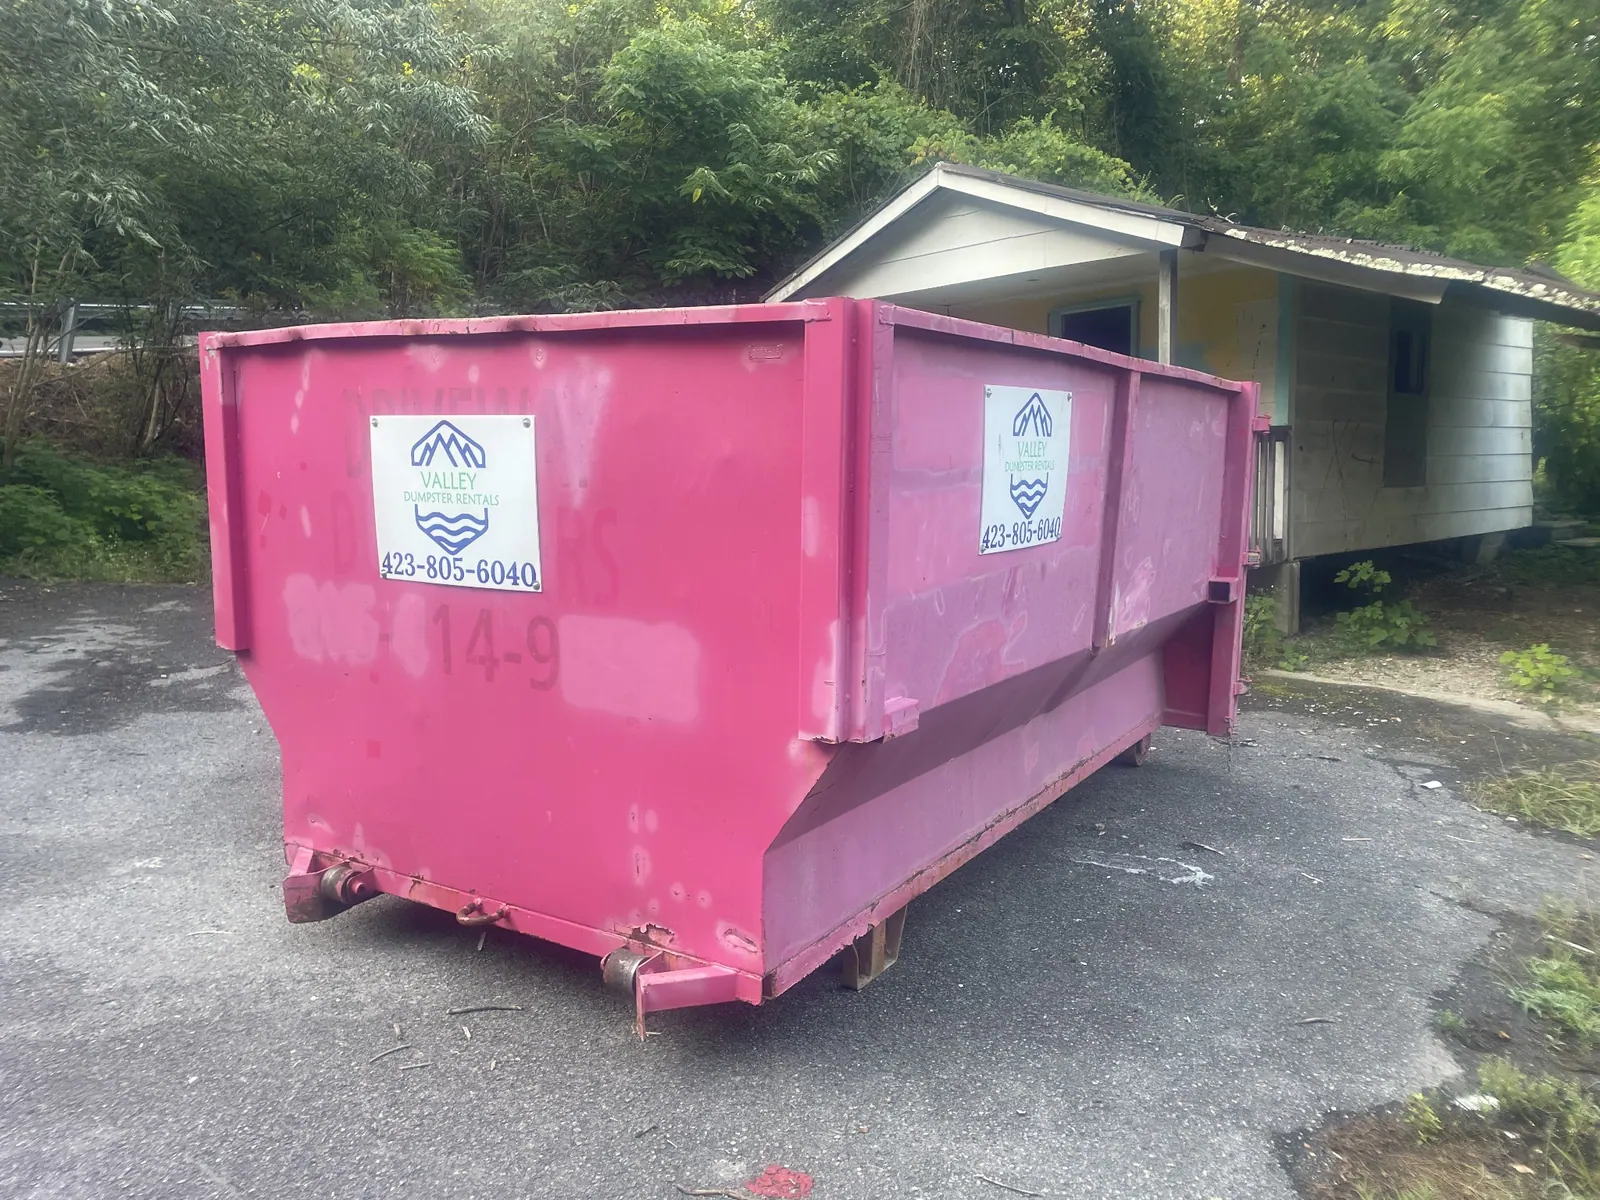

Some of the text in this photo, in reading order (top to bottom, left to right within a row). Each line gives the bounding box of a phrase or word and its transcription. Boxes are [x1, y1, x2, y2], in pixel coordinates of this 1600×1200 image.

[1017, 441, 1047, 458] VALLEY
[1004, 460, 1055, 472] DUMPSTER RENTALS
[420, 471, 477, 490] VALLEY
[403, 491, 500, 506] DUMPSTER RENTALS
[982, 516, 1061, 549] 423-805-6040
[381, 551, 537, 588] 423-805-6040
